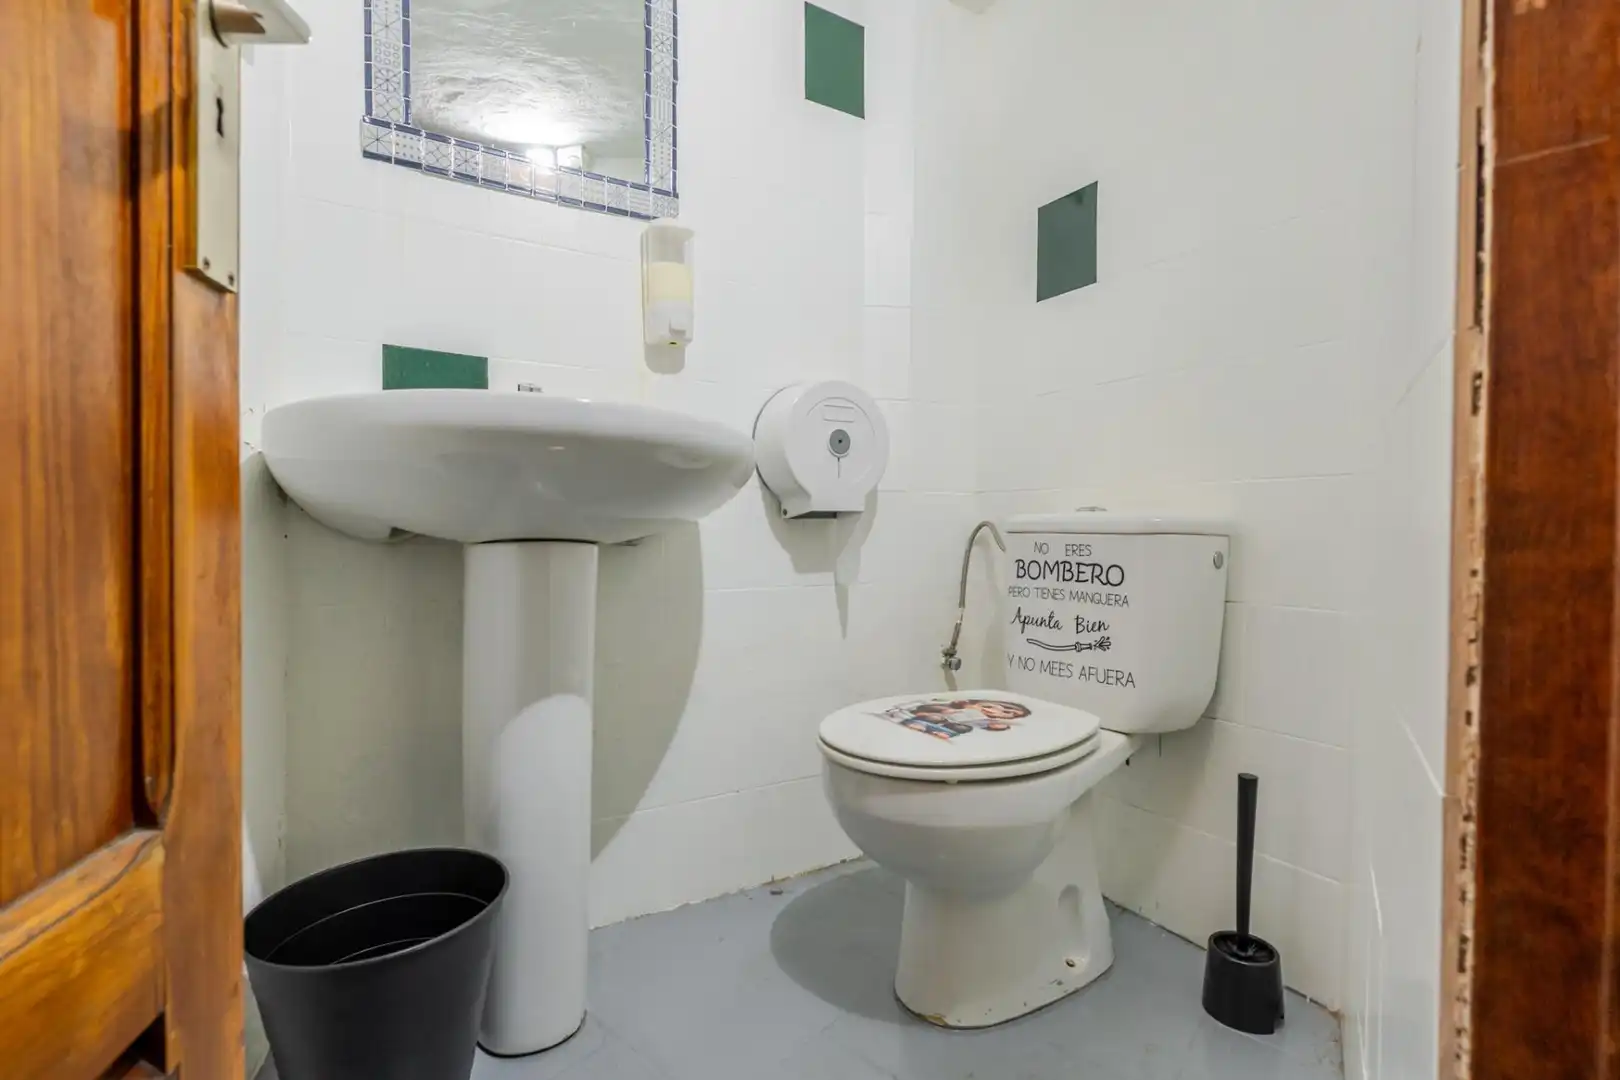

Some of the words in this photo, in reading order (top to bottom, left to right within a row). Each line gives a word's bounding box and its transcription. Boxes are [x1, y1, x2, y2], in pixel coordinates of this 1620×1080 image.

[1033, 541, 1050, 555] NO
[1065, 543, 1093, 558] ERES
[1014, 559, 1125, 587] BOMBERO
[1008, 586, 1031, 598] PERO
[1069, 591, 1130, 608] MANGUERA
[1011, 606, 1063, 634] Apunta
[1074, 614, 1110, 635] Bien
[1007, 654, 1015, 668] Y
[1018, 656, 1036, 672] NO
[1039, 660, 1074, 679] MEES
[1078, 665, 1136, 689] AFUERA
